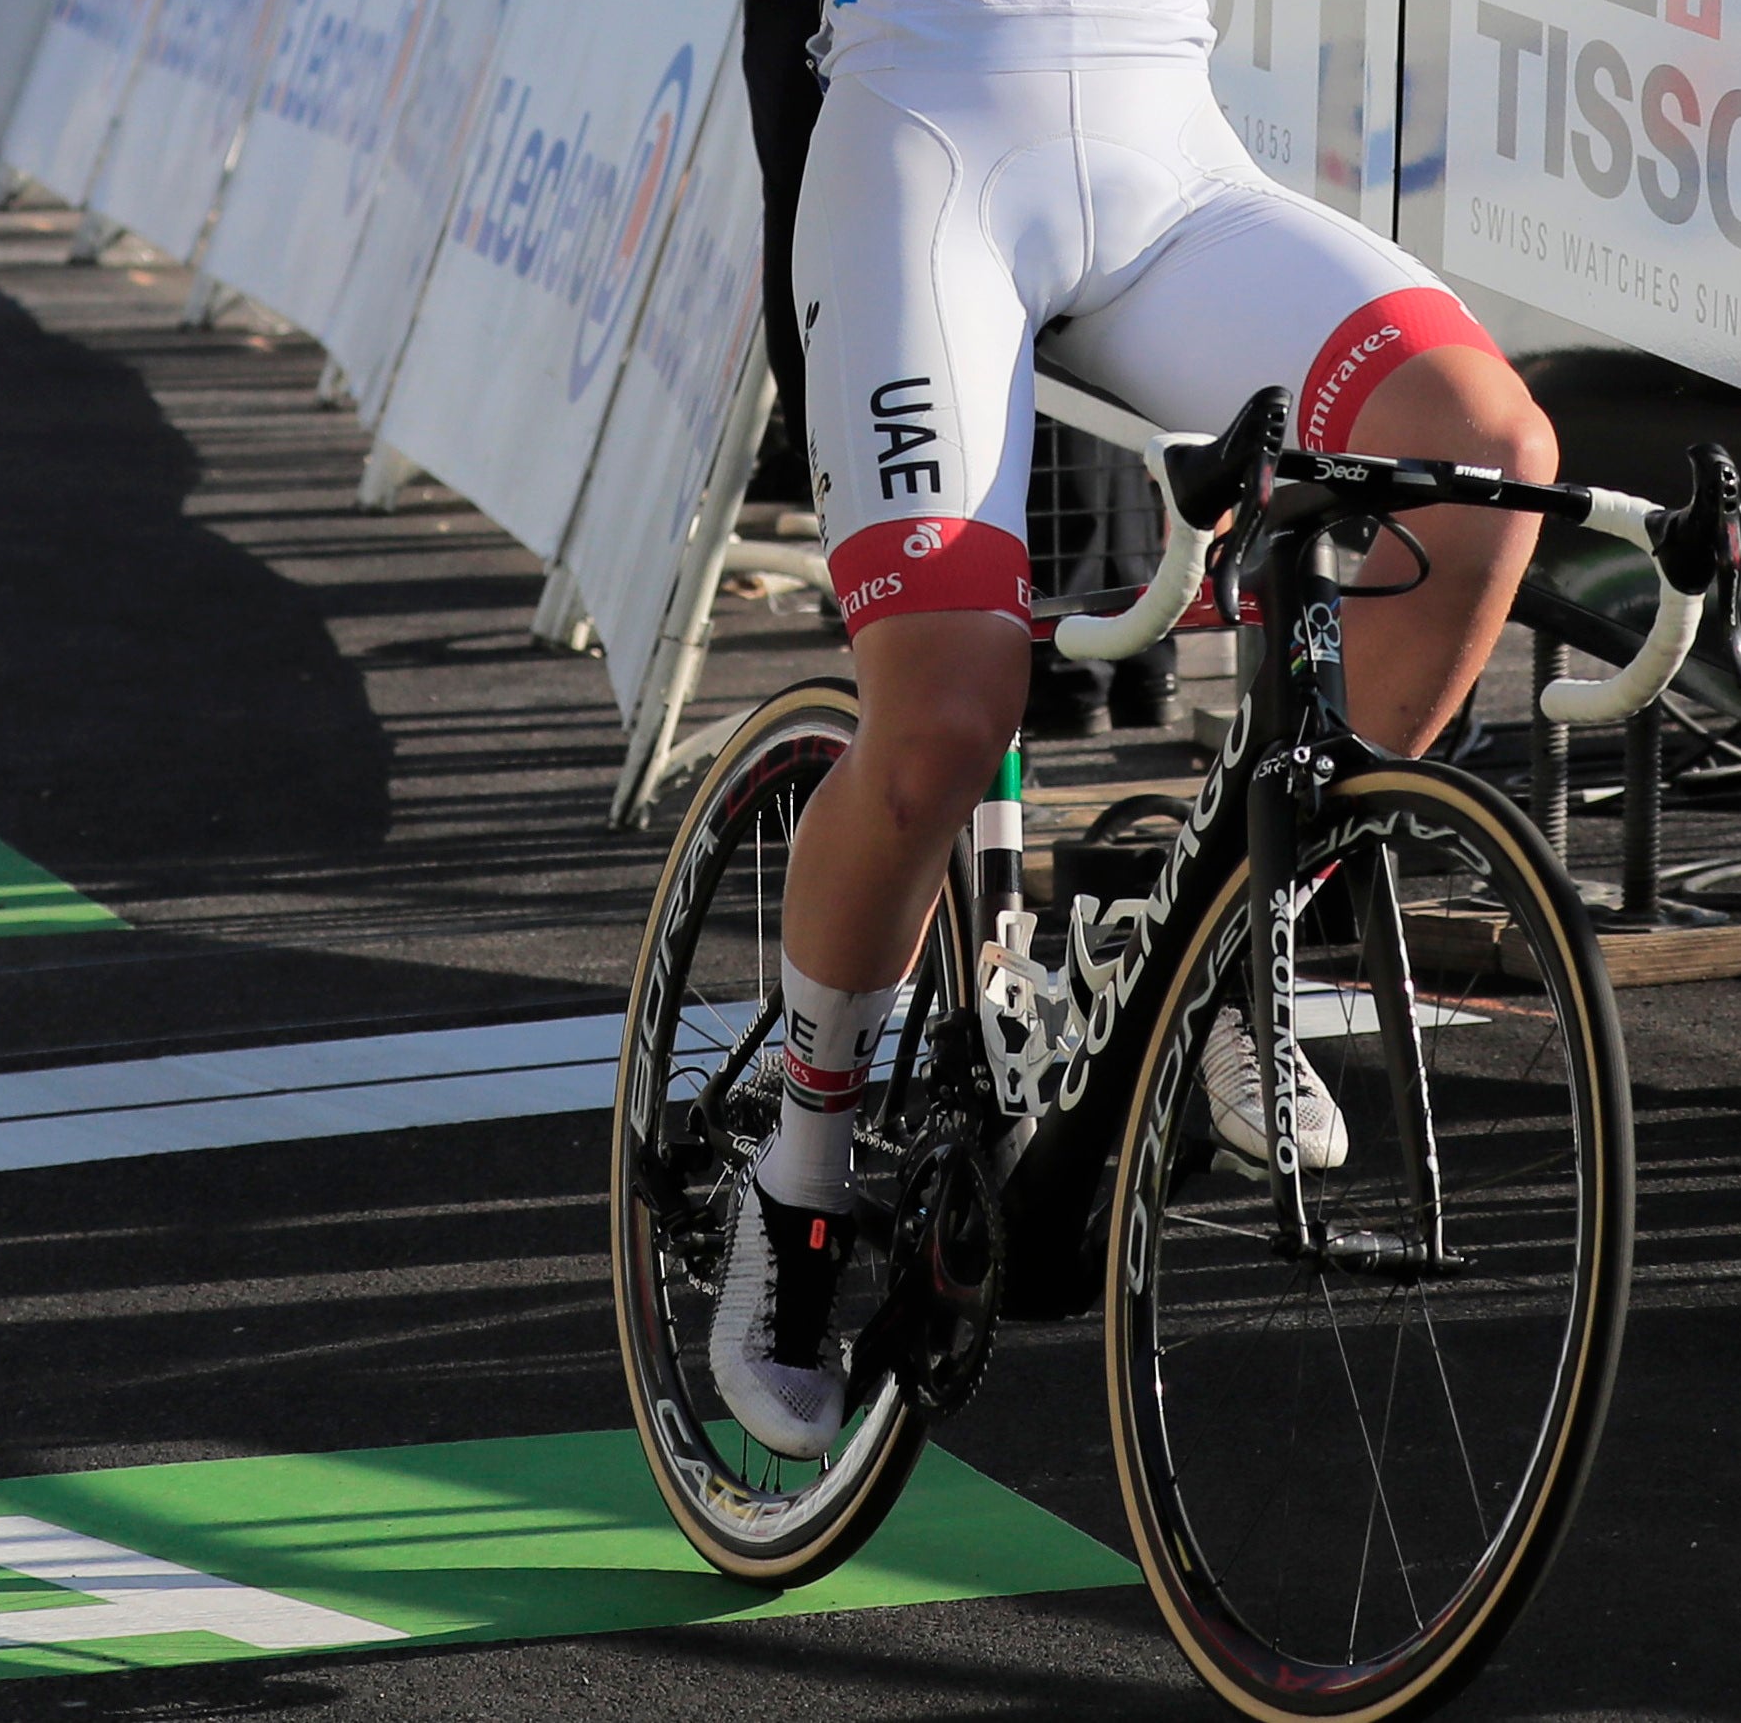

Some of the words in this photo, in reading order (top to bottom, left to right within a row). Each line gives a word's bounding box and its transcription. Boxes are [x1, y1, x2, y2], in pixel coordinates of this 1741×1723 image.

[1470, 196, 1548, 261] SWISS
[1562, 230, 1680, 314] WATCHES
[870, 376, 942, 501] UAE
[1304, 324, 1402, 454] Emirates
[836, 571, 904, 621] irates
[1059, 690, 1253, 1112] COLNAGO
[1270, 926, 1299, 1175] COLNAGO
